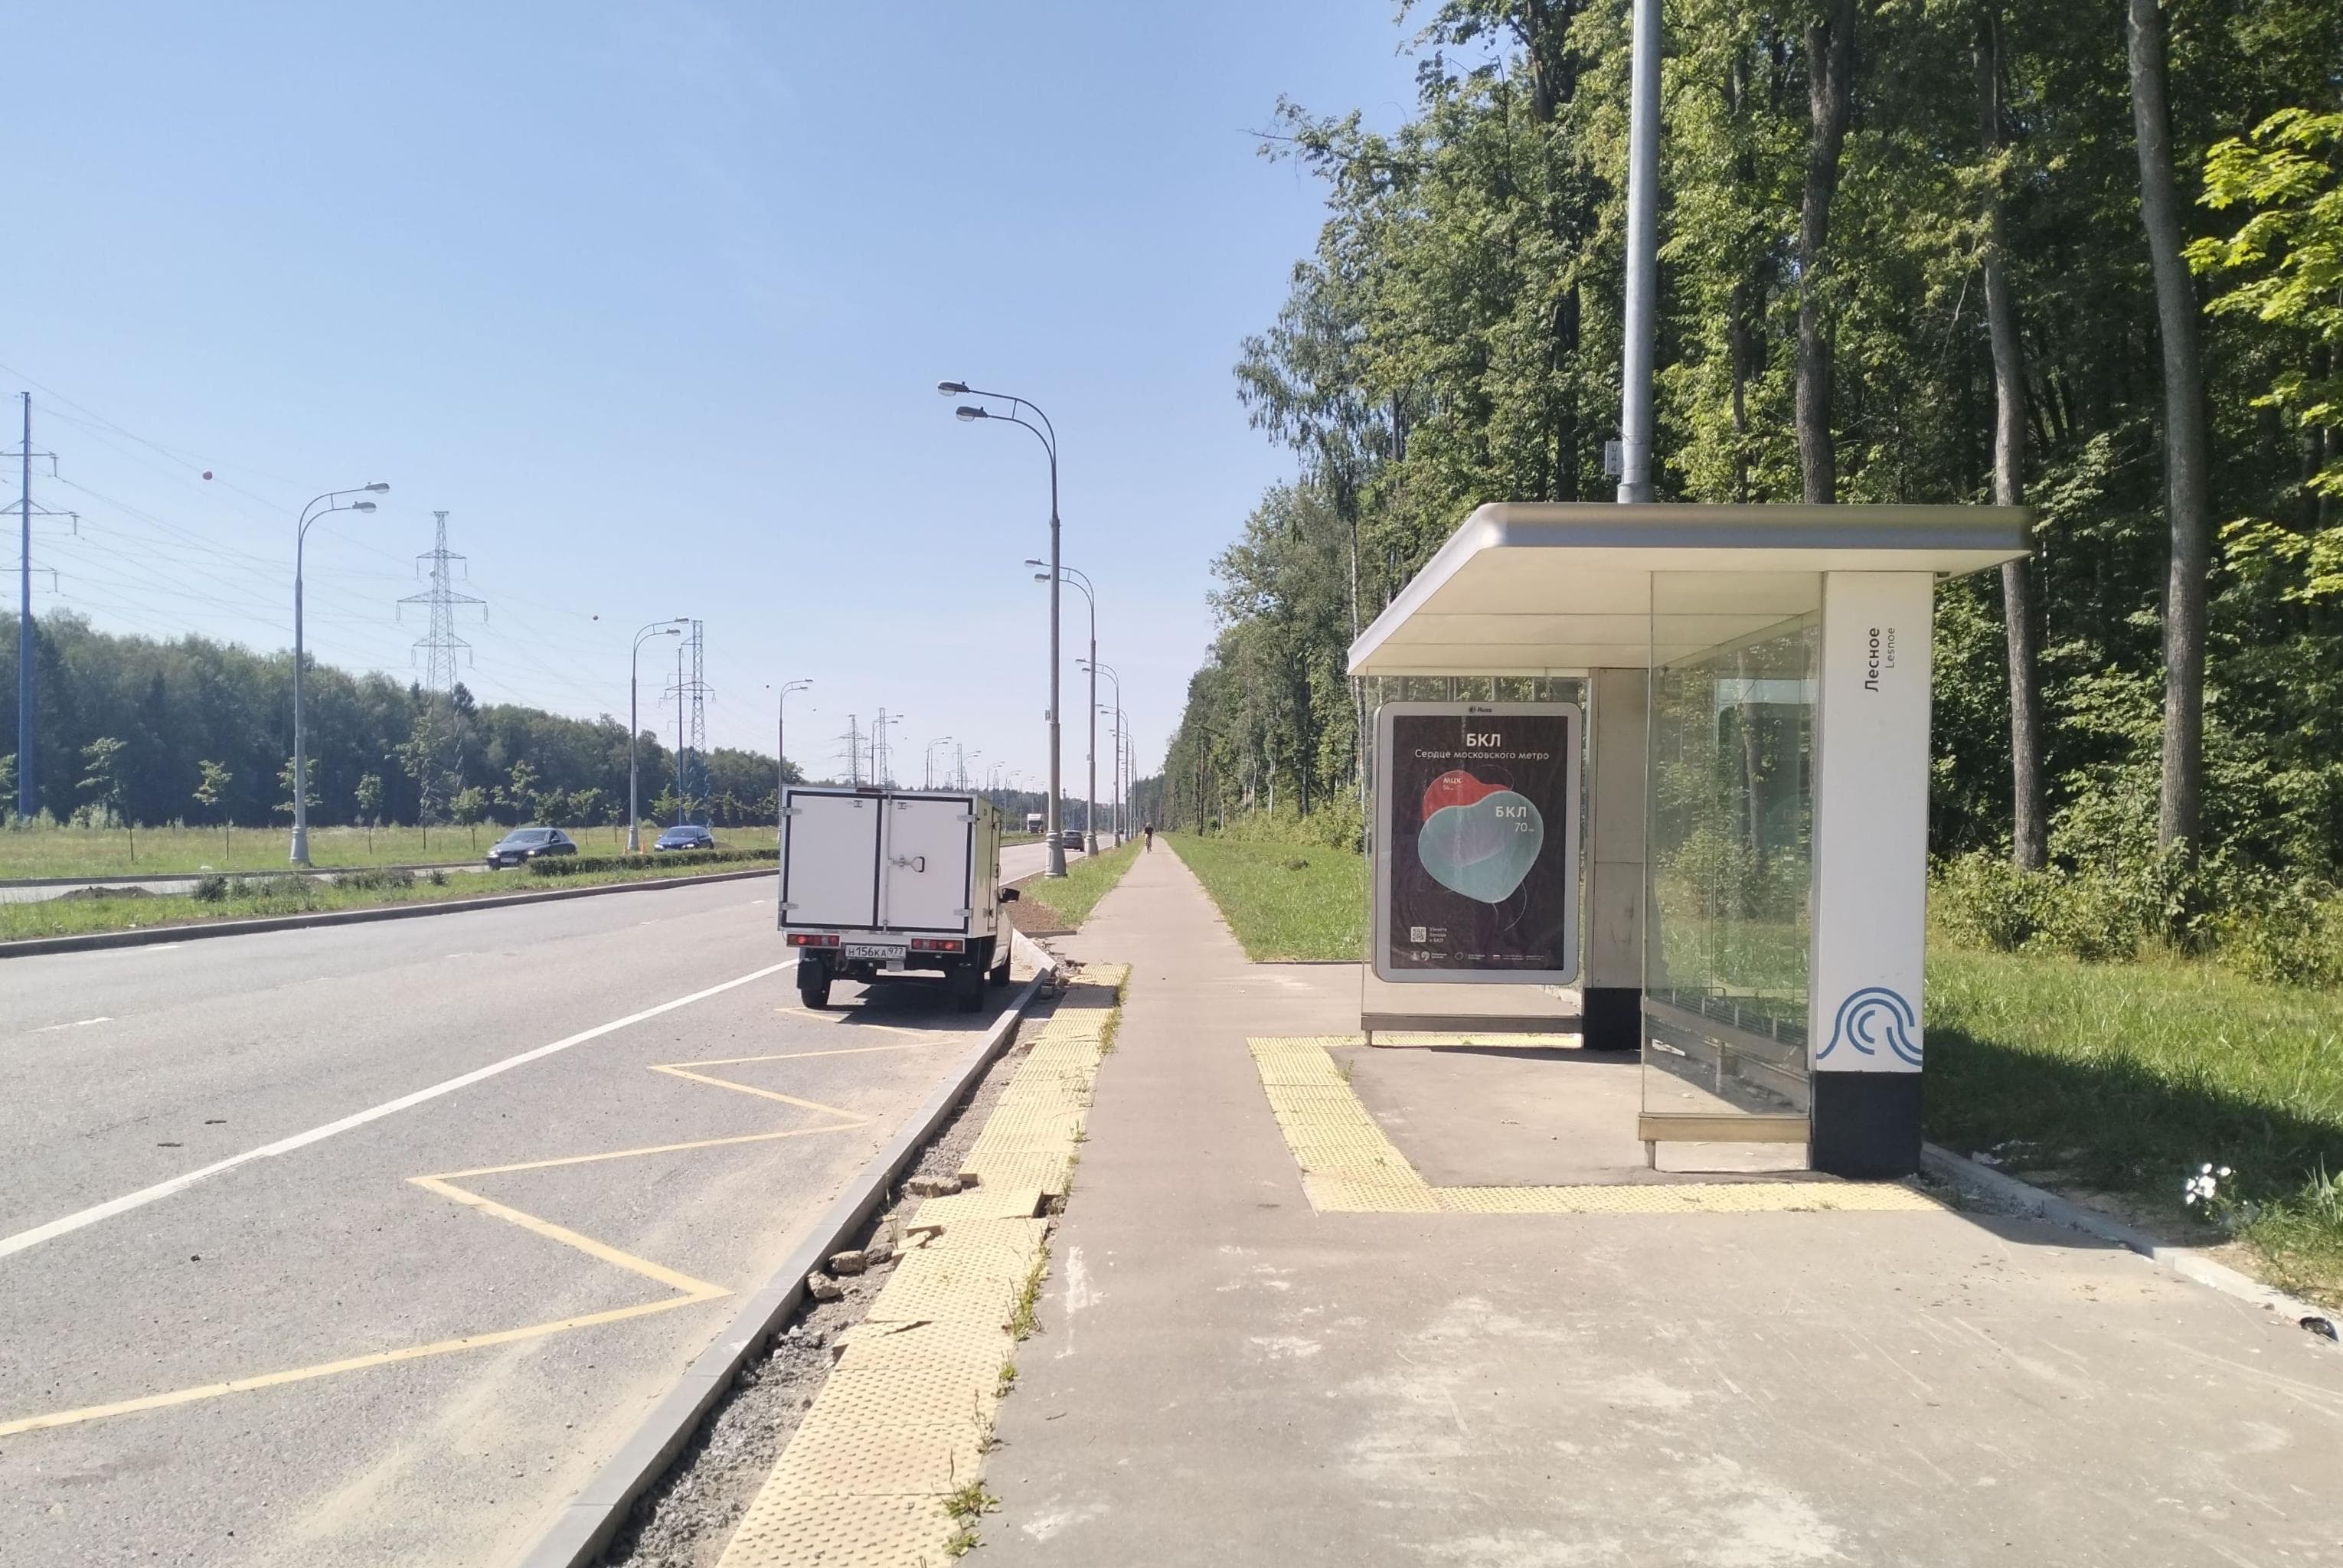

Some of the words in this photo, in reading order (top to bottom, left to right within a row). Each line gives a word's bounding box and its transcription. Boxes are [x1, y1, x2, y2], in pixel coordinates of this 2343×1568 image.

[1885, 628, 1895, 668] Lesnoe
[1864, 628, 1880, 692] Лесное
[1466, 733, 1501, 747] БКЛ
[1414, 749, 1451, 760] Сердце
[1454, 751, 1516, 760] московского
[1495, 806, 1527, 818] БКЛ
[1515, 822, 1528, 832] 70
